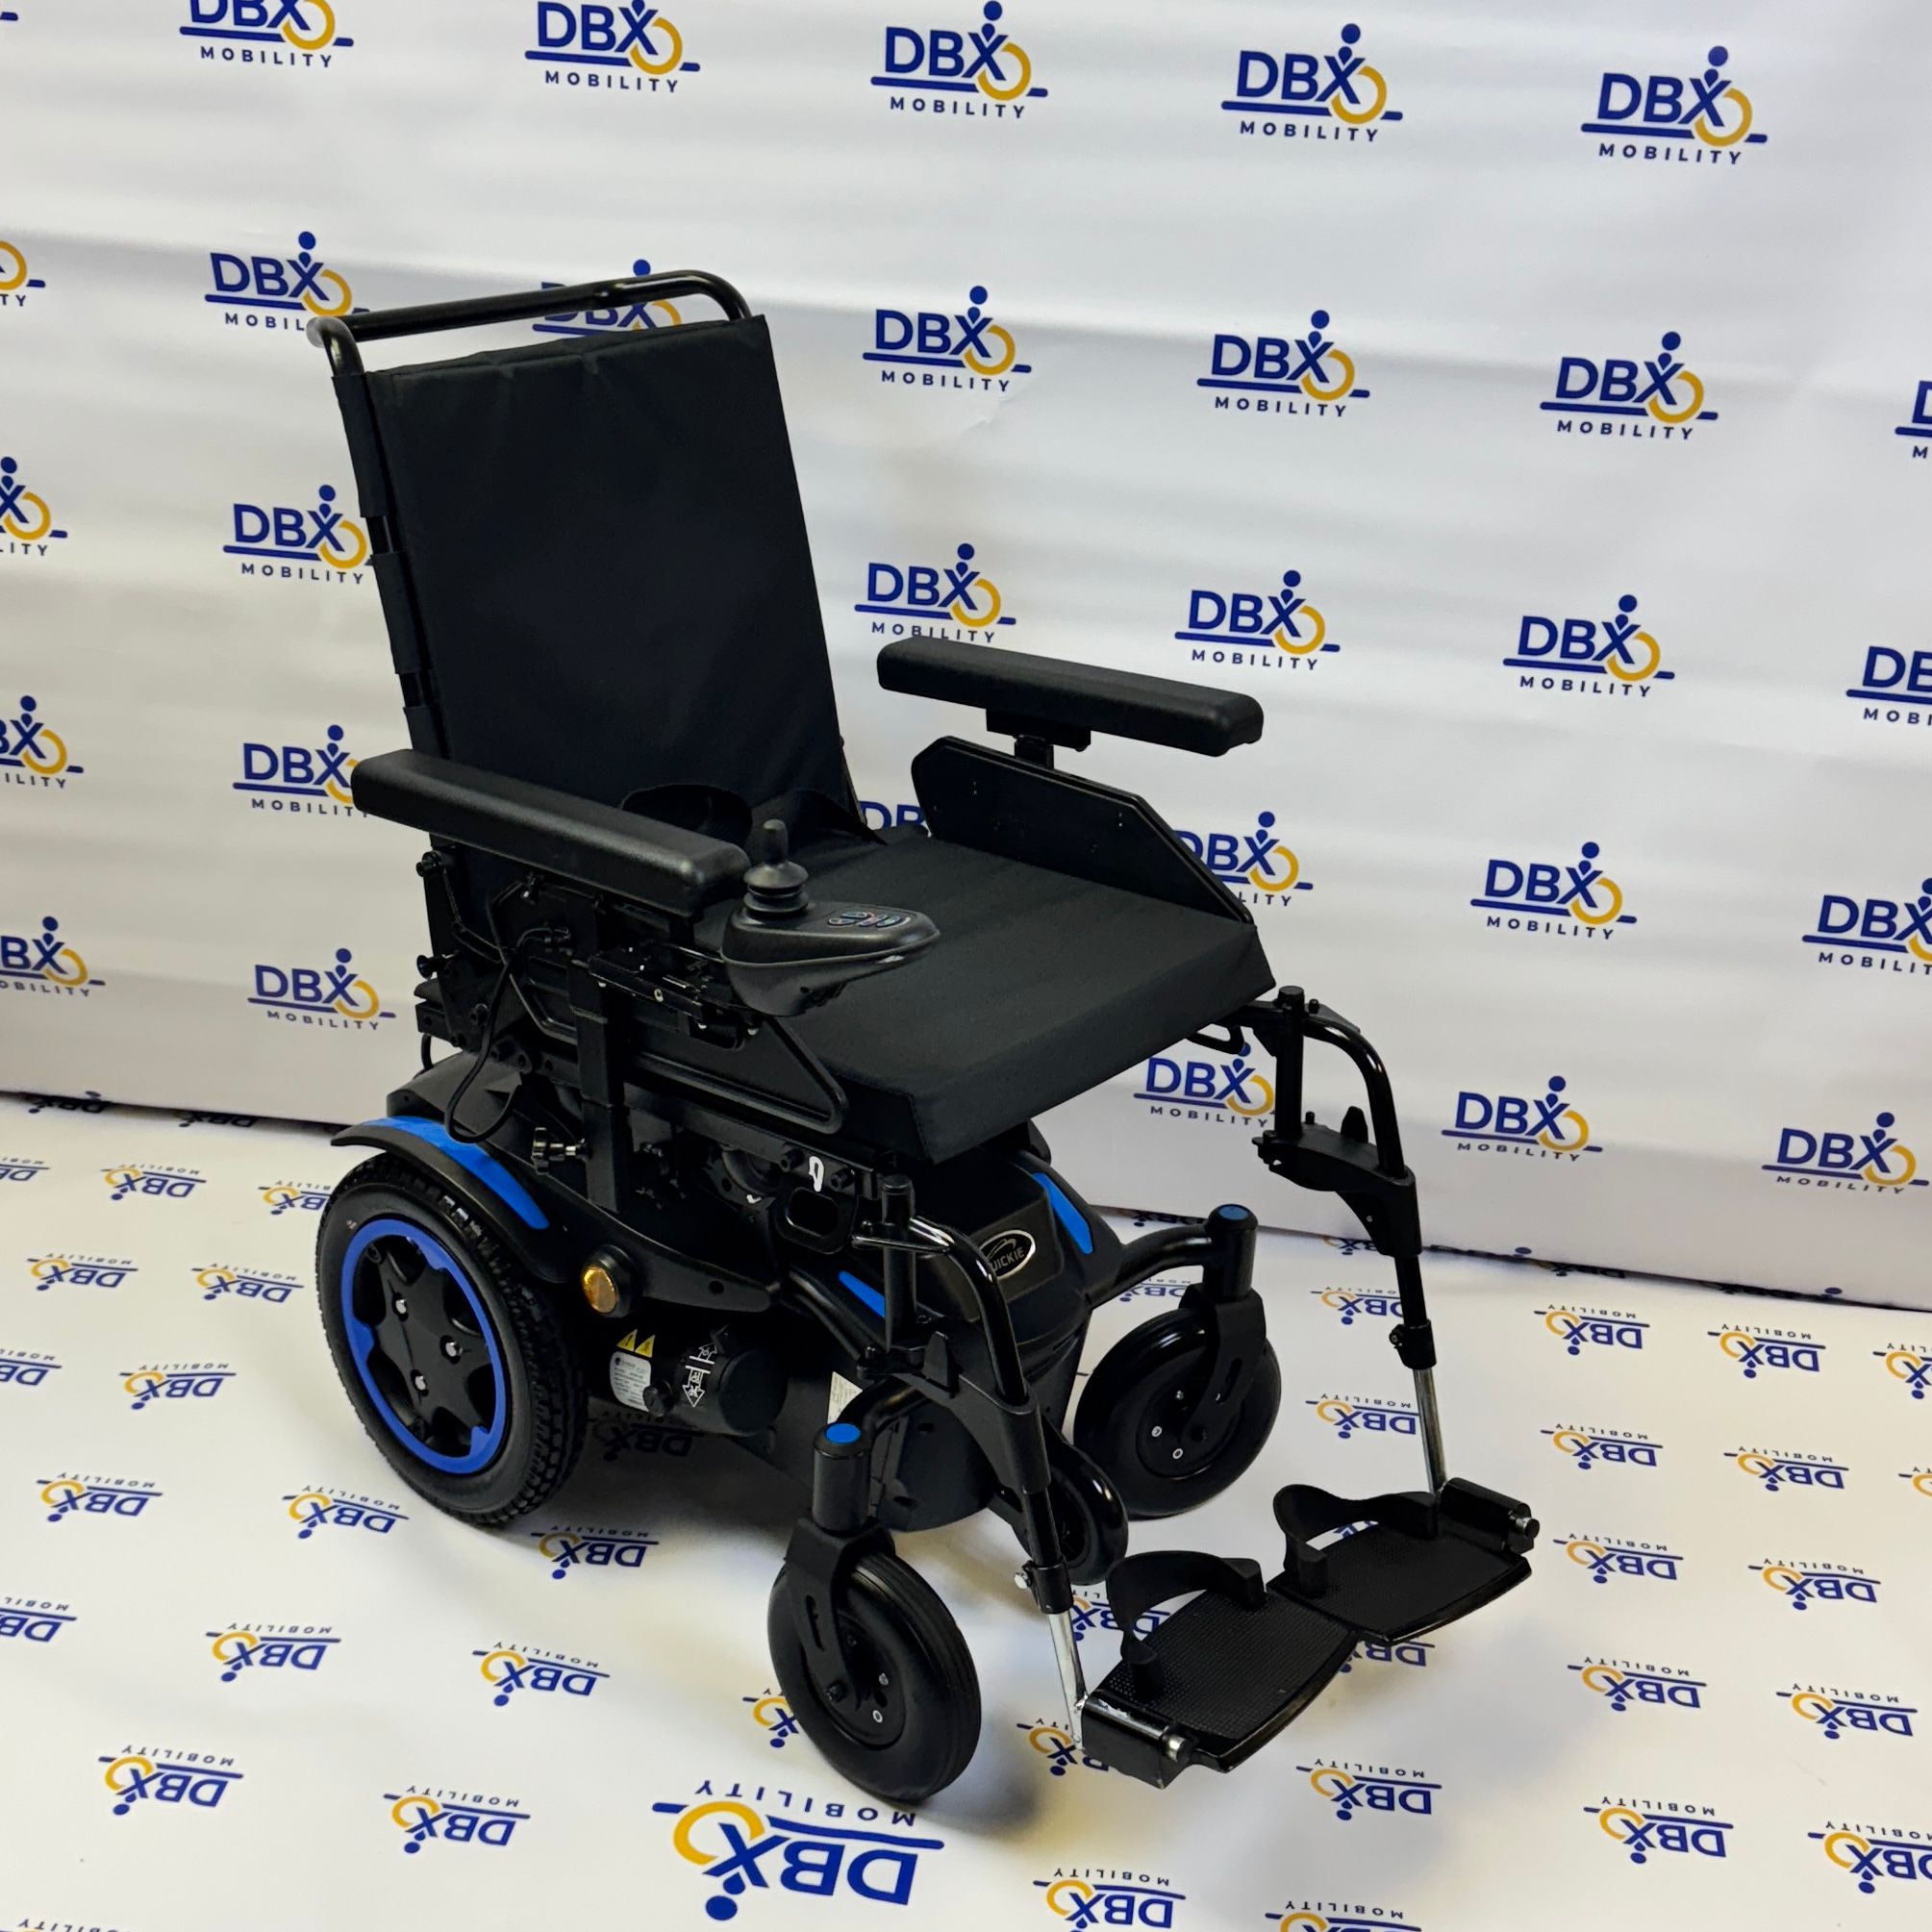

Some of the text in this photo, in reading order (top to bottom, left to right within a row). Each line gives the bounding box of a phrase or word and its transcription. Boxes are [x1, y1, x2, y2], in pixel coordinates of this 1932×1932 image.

[538, 0, 658, 55] DBX
[201, 46, 331, 67] MOBILITY
[885, 23, 1008, 81] DBX
[545, 70, 678, 92] MOBILITY
[1237, 46, 1366, 104] DBX
[891, 96, 1024, 118] MOBILITY
[1597, 68, 1731, 127] DBX
[1240, 120, 1378, 142] MOBILITY
[1598, 143, 1741, 164] MOBILITY
[210, 252, 330, 301] DBX
[225, 313, 305, 331] MOBIL
[875, 307, 992, 358] DBX
[1212, 331, 1334, 383] DBX
[882, 370, 1010, 392] MOBILITY
[1556, 353, 1684, 405] DBX
[1215, 396, 1346, 417] MOBILITY
[1557, 419, 1693, 439] MOBILITY
[234, 503, 344, 552] DBX
[241, 563, 363, 585] MOBILITY
[867, 562, 980, 611] DBX
[1189, 589, 1306, 638] DBX
[871, 622, 994, 643] MOBILITY
[1518, 614, 1641, 665] DBX
[1192, 649, 1317, 670] MOBILITY
[1862, 646, 1932, 692] DB
[1520, 675, 1650, 697] MOBILITY
[1864, 708, 1932, 726] MOBI
[242, 742, 350, 788] DBX
[5, 773, 65, 789] ILITY
[1485, 860, 1603, 908] DBX
[1239, 891, 1292, 906] LITY
[1487, 916, 1614, 940] MOBILITY
[1818, 895, 1932, 944] DBX
[0, 936, 68, 974] BX
[1819, 952, 1932, 975] MOBILIT
[0, 981, 90, 997] OBILITY
[255, 965, 359, 1006] DBX
[267, 1011, 378, 1030] MOBILITY
[1145, 1058, 1256, 1104] DBX
[1150, 1105, 1267, 1128] MOBILITY
[1455, 1091, 1569, 1140] DBX
[1457, 1142, 1580, 1162] MOBILITY
[1777, 1128, 1897, 1173] DBX
[114, 1173, 194, 1198] DBX
[276, 1180, 332, 1191] BILITY
[1777, 1176, 1904, 1194] MOBILITY
[274, 1193, 327, 1211] BX
[41, 1266, 126, 1288] DBX
[212, 1264, 296, 1281] MOBILITY
[205, 1276, 292, 1302] DBX
[1548, 1305, 1636, 1318] MOBILITY
[1564, 1320, 1643, 1349] DBX
[1721, 1324, 1811, 1340] MOBILITY
[139, 1362, 229, 1371] MOBILITY
[1737, 1342, 1819, 1372] DBX
[135, 1377, 223, 1397] DBX
[1321, 1393, 1411, 1408] MOBILITY
[1334, 1408, 1417, 1435] DBX
[1556, 1423, 1647, 1440] MOBILITY
[1568, 1439, 1657, 1467] DBX
[1739, 1446, 1832, 1462] MOBILITY
[58, 1472, 155, 1488] MOBILITY
[1754, 1462, 1845, 1489] DBX
[49, 1490, 149, 1517] DBX
[303, 1486, 399, 1510] MOBILITY
[300, 1502, 397, 1533] DBX
[550, 1524, 649, 1537] MOBILITY
[1569, 1534, 1667, 1551] MOBILITY
[552, 1542, 647, 1568] DBX
[1584, 1549, 1677, 1581] DBX
[1764, 1559, 1864, 1574] MOBILITY
[1785, 1575, 1877, 1603] DBX
[6, 1597, 68, 1611] MOBIL
[0, 1616, 63, 1643] DB
[228, 1623, 332, 1634] MOBILITY
[224, 1643, 326, 1670] DBX
[494, 1642, 598, 1668] MOBILITY
[1352, 1641, 1426, 1667] DB
[494, 1661, 597, 1696] DBX
[1585, 1657, 1690, 1676] MOBILITY
[1602, 1675, 1701, 1709] DBX
[1793, 1684, 1898, 1703] MOBILITY
[1815, 1701, 1914, 1737] DBX
[122, 1745, 234, 1767] MOBILITY
[1315, 1759, 1424, 1778] MOBILITY
[116, 1769, 229, 1807] DBX
[407, 1786, 519, 1807] MOBILITY
[1331, 1775, 1432, 1816] DBX
[694, 1779, 916, 1826] MOBILITY
[1602, 1796, 1715, 1816] MOBILITY
[406, 1808, 516, 1845] DBX
[1620, 1819, 1727, 1858] DBX
[702, 1822, 919, 1906] DBX
[1054, 1868, 1169, 1886] MOBILITY
[1061, 1893, 1174, 1930] DBX
[1286, 1900, 1403, 1919] MOBILITY
